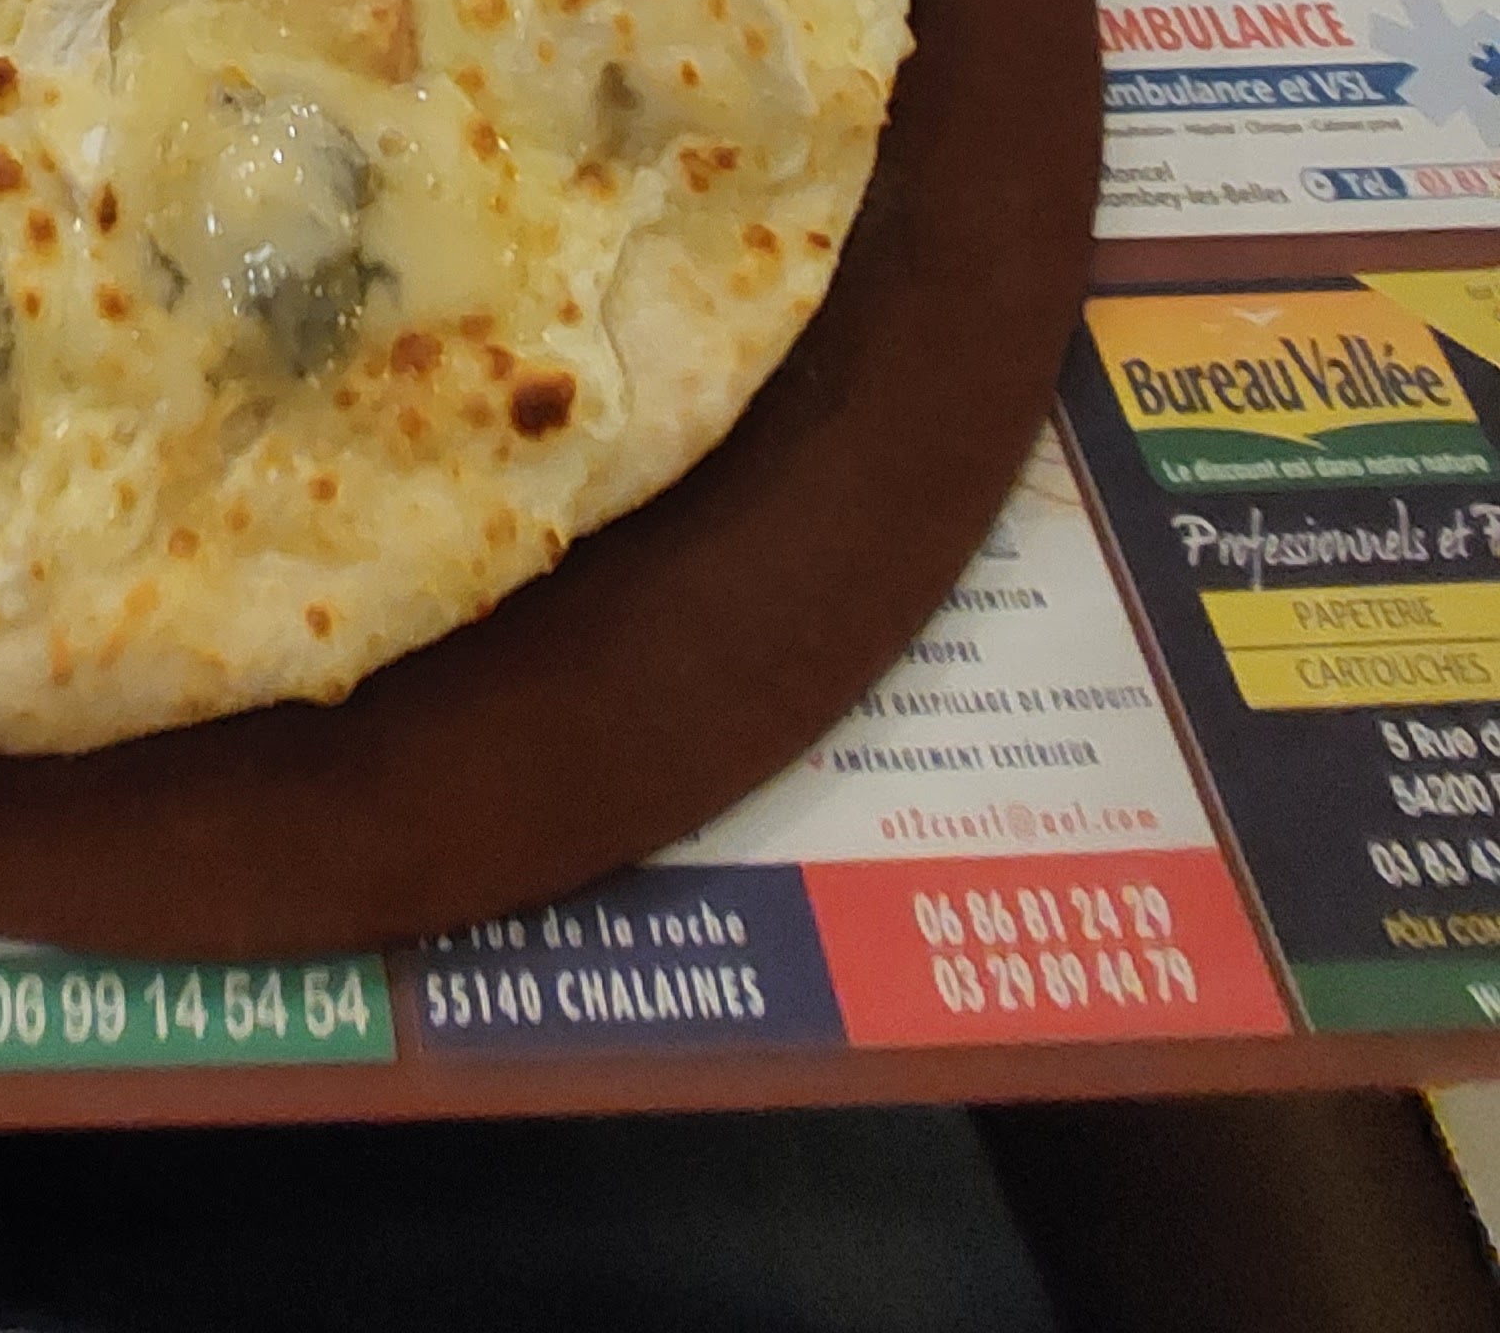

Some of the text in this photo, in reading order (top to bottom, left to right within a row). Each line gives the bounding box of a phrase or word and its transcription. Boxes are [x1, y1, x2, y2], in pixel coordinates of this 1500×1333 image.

[1099, 1, 1355, 53] MBULANCE
[1278, 74, 1314, 103] et
[1317, 70, 1387, 101] VSL
[1122, 333, 1453, 417] Bureau Vallée
[1170, 497, 1431, 593] Professionnels
[1437, 509, 1474, 560] et
[1291, 596, 1443, 632] PAPETERIE
[1295, 651, 1493, 691] CARTOUCHES
[595, 900, 635, 949] la
[61, 970, 127, 1044] 99
[144, 967, 210, 1042] 14
[222, 967, 290, 1042] 54
[304, 965, 371, 1041] 54
[425, 964, 767, 1029] 55140 CHALAINES
